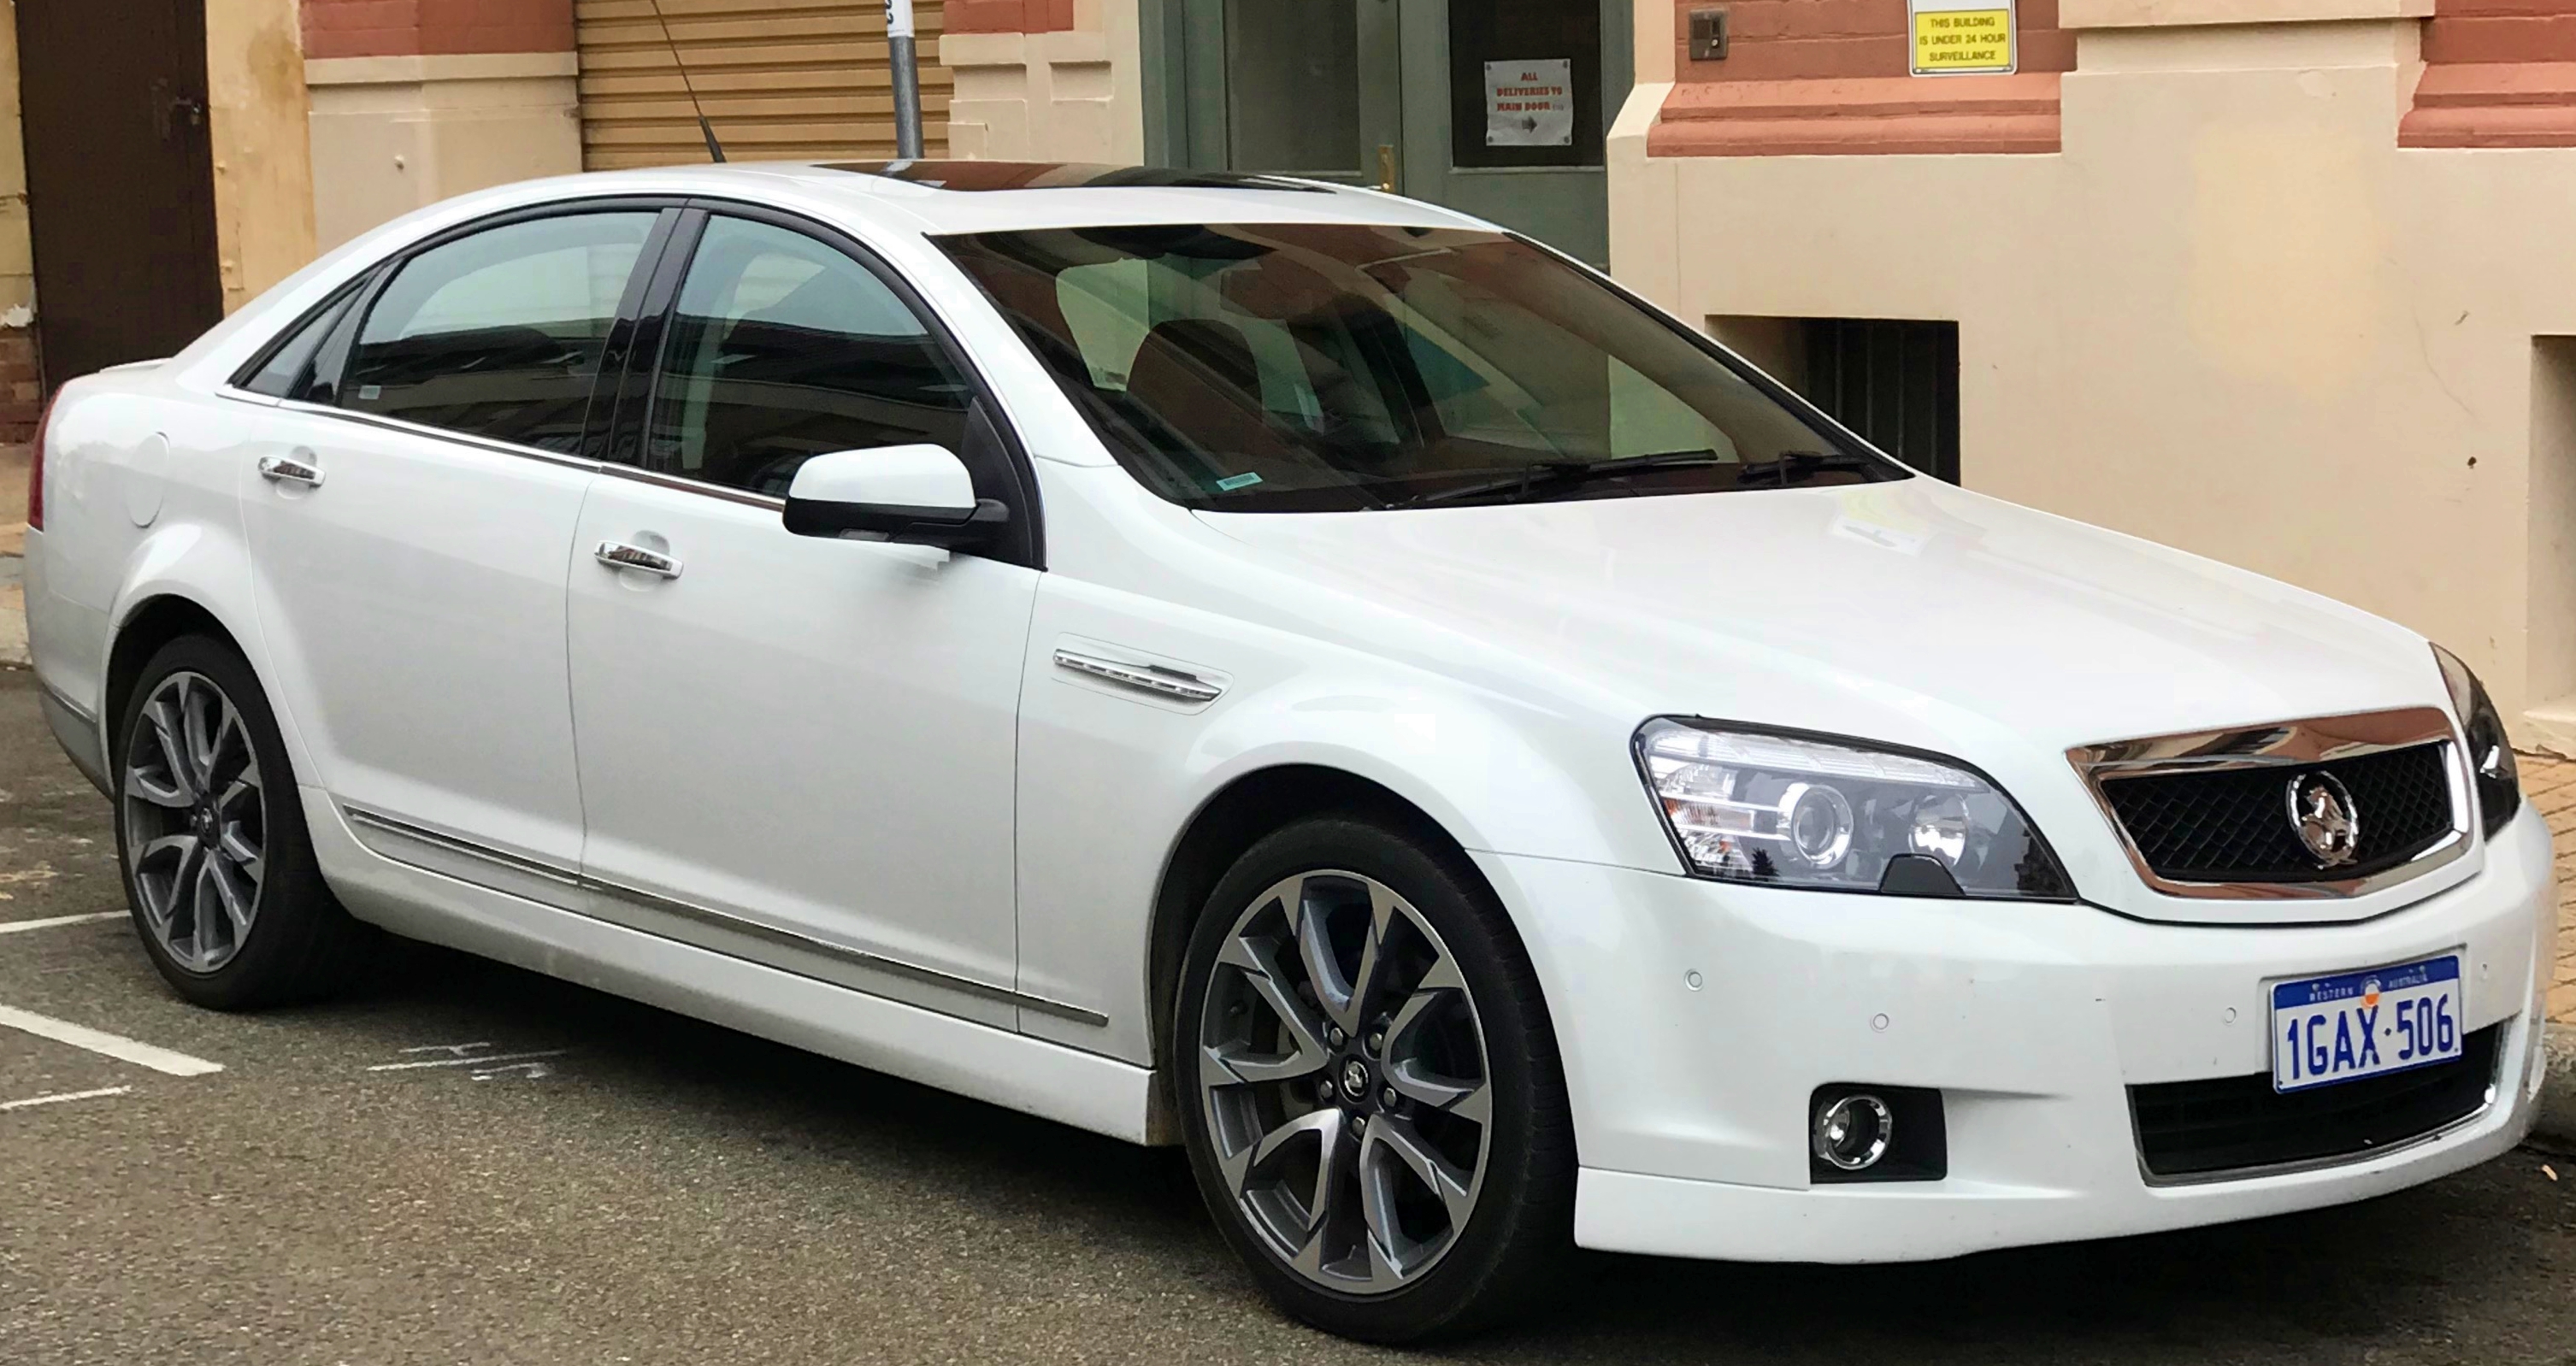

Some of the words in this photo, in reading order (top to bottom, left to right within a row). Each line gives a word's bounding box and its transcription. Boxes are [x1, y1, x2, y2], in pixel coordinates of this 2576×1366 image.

[1931, 18, 1949, 28] THIS
[1954, 17, 1995, 27] BUILDING
[1919, 36, 1928, 45] IS
[1932, 35, 1962, 44] UNDER
[1966, 34, 1977, 44] 24
[1980, 33, 2006, 44] HOUR
[1930, 50, 1996, 62] SURVEILLANCE
[1521, 72, 1538, 81] ALL
[1496, 87, 1549, 97] DELIVERIES
[1551, 86, 1562, 96] TO
[1497, 103, 1522, 111] MAIN
[1525, 102, 1550, 111] DOOR
[2310, 987, 2354, 1002] WESTERN
[2388, 974, 2428, 988] AUSTRALIA
